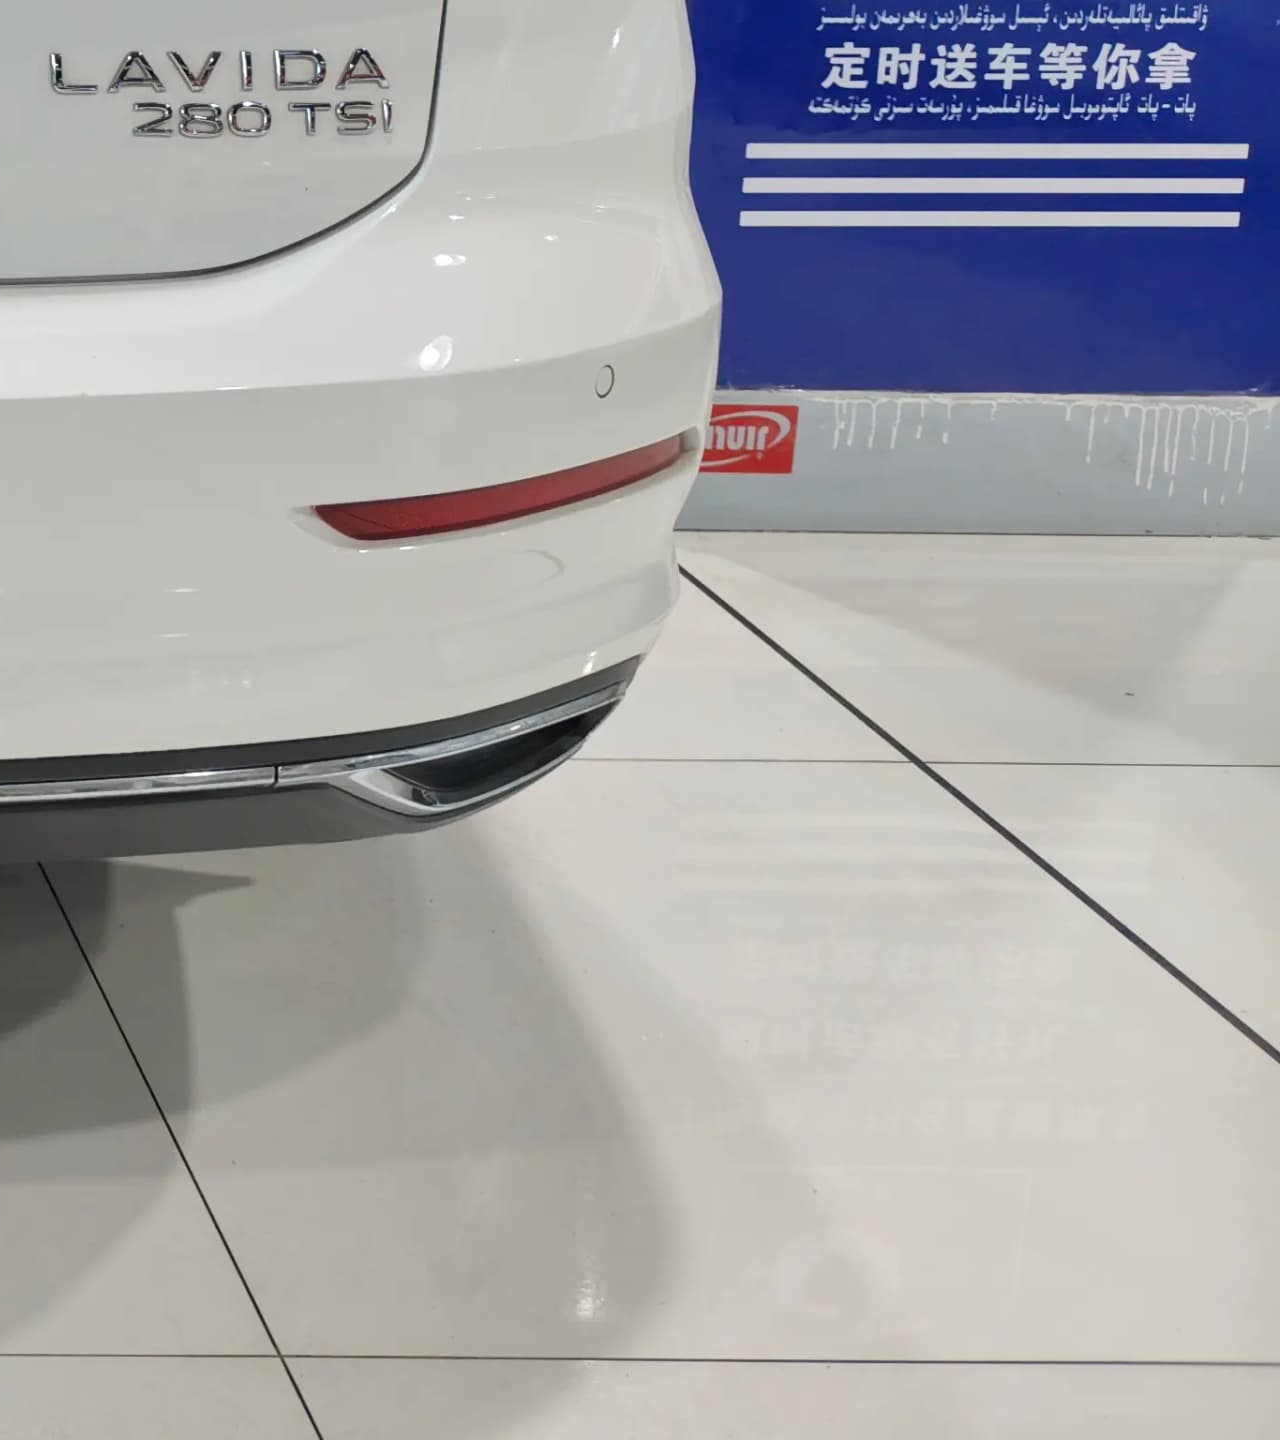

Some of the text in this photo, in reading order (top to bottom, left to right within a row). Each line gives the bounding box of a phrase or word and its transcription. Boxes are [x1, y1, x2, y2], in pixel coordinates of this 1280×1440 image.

[49, 47, 391, 95] LAVIDA
[821, 42, 1197, 90] 定时送车等你拿
[132, 100, 273, 138] 280
